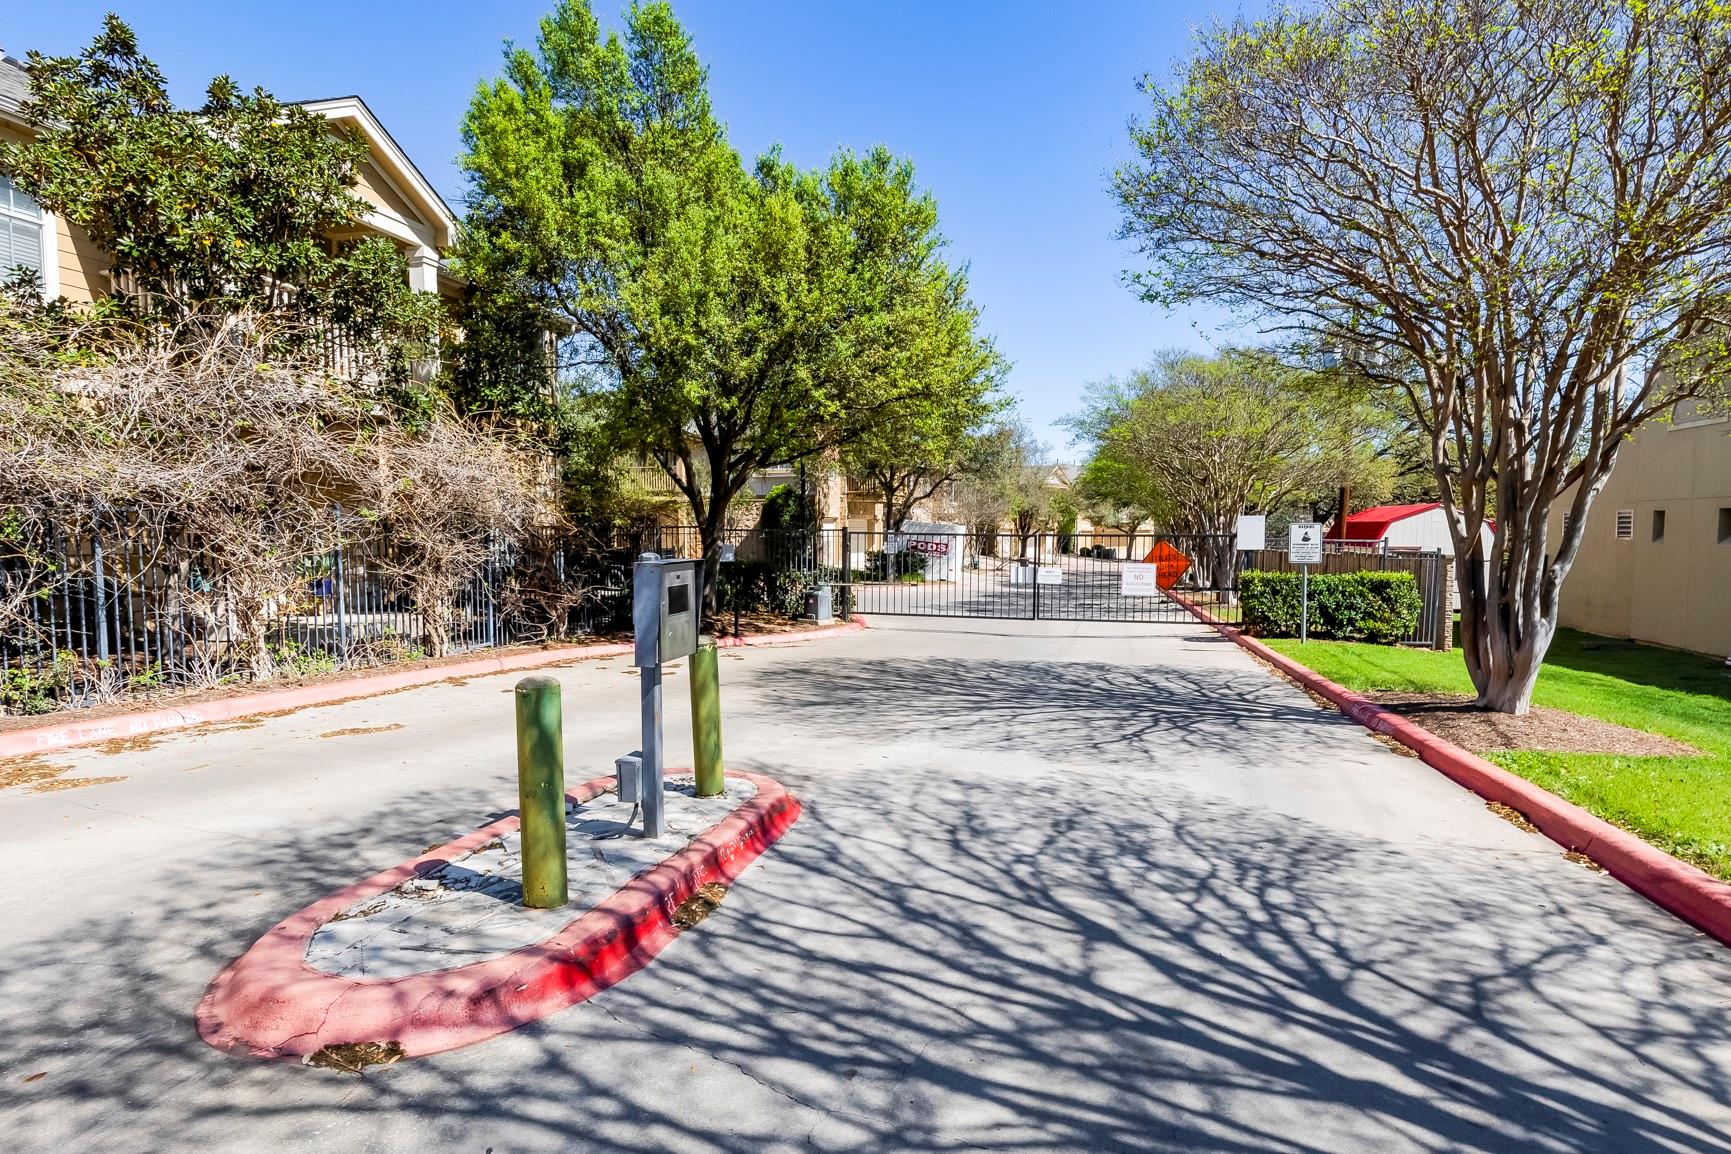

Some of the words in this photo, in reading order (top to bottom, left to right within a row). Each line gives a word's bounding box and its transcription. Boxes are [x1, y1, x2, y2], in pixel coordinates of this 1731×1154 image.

[908, 540, 947, 551] PODS
[36, 732, 69, 746] FIRE
[79, 727, 114, 740] LANE
[129, 719, 148, 734] NO
